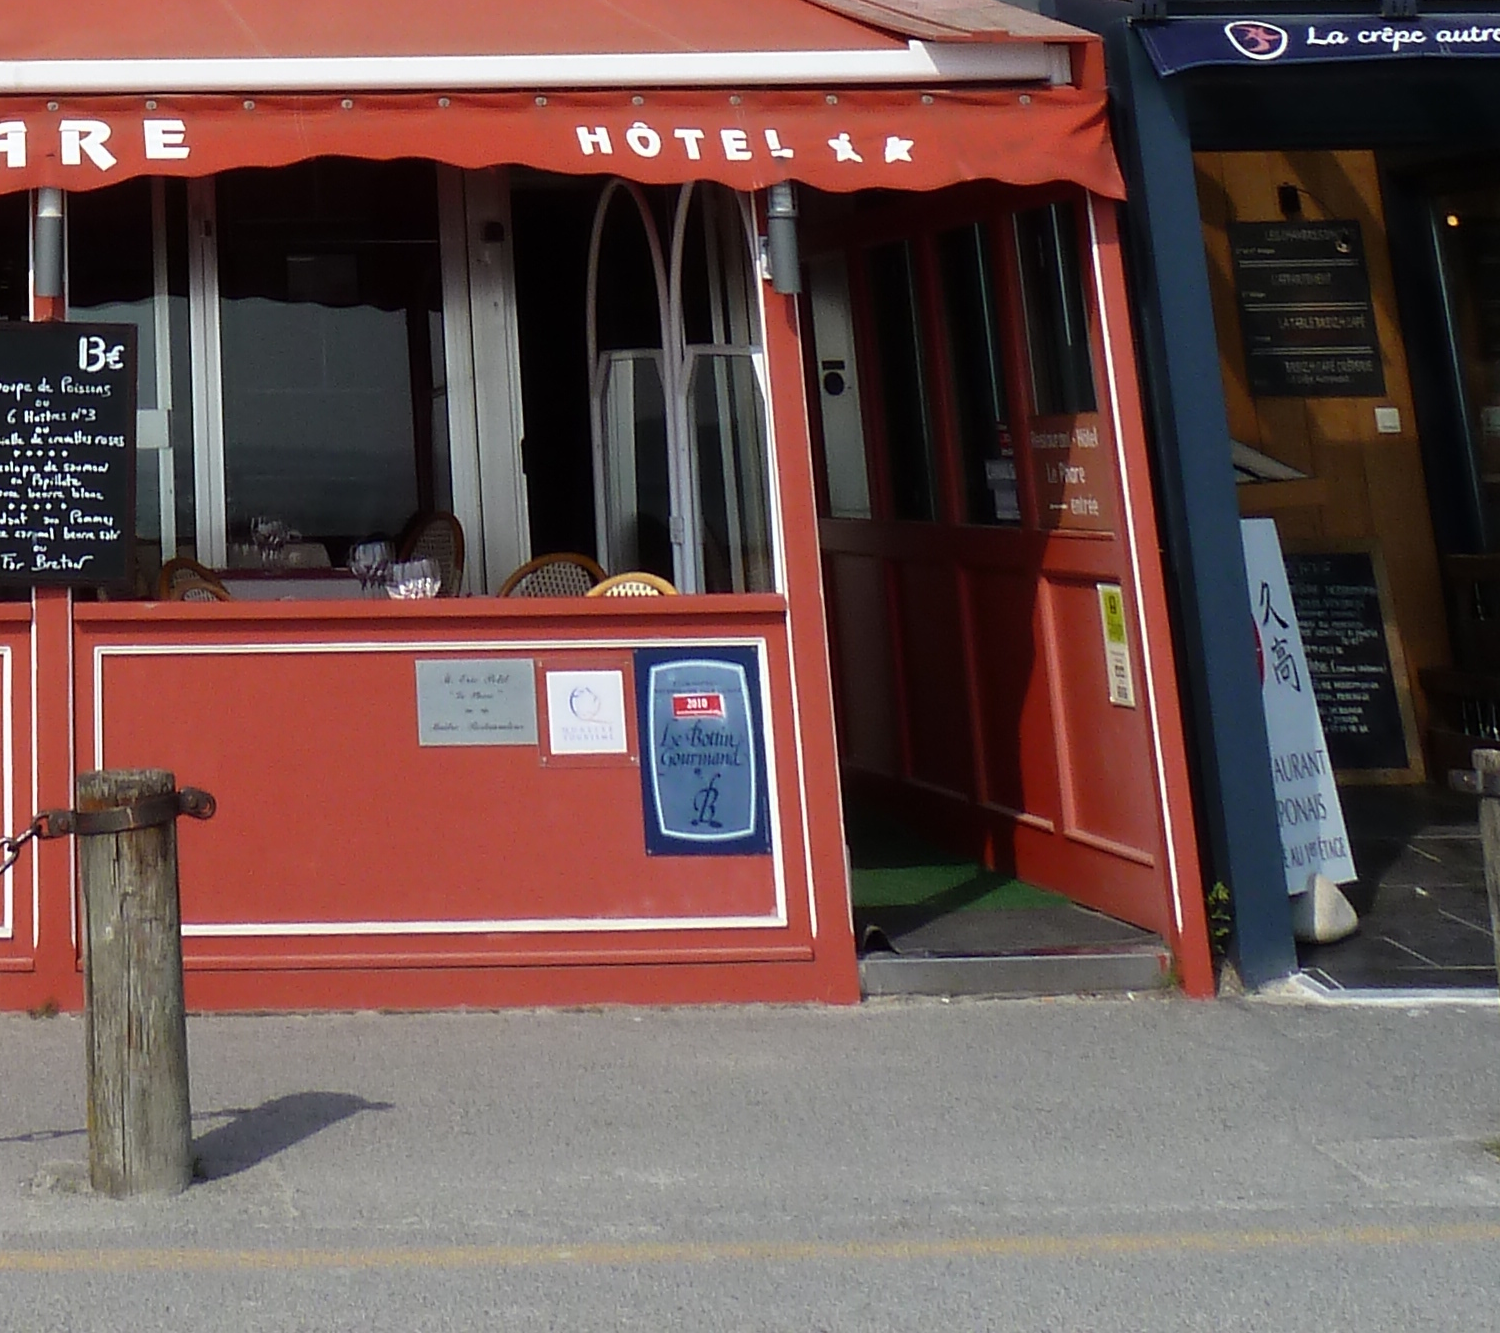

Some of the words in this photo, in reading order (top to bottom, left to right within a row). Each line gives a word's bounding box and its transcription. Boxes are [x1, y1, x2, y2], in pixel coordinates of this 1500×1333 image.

[1306, 26, 1349, 44] La
[1357, 26, 1427, 52] crêpe
[574, 121, 795, 161] HÔTEL
[78, 335, 125, 373] 13€
[37, 377, 54, 394] de
[61, 376, 112, 397] Poissons
[35, 399, 51, 408] ou
[7, 408, 17, 424] 6
[35, 426, 50, 435] ou
[30, 432, 44, 446] de
[94, 435, 126, 448] roses
[43, 460, 59, 473] de
[32, 544, 48, 553] ou
[0, 552, 26, 571] Far
[686, 697, 708, 710] 2010
